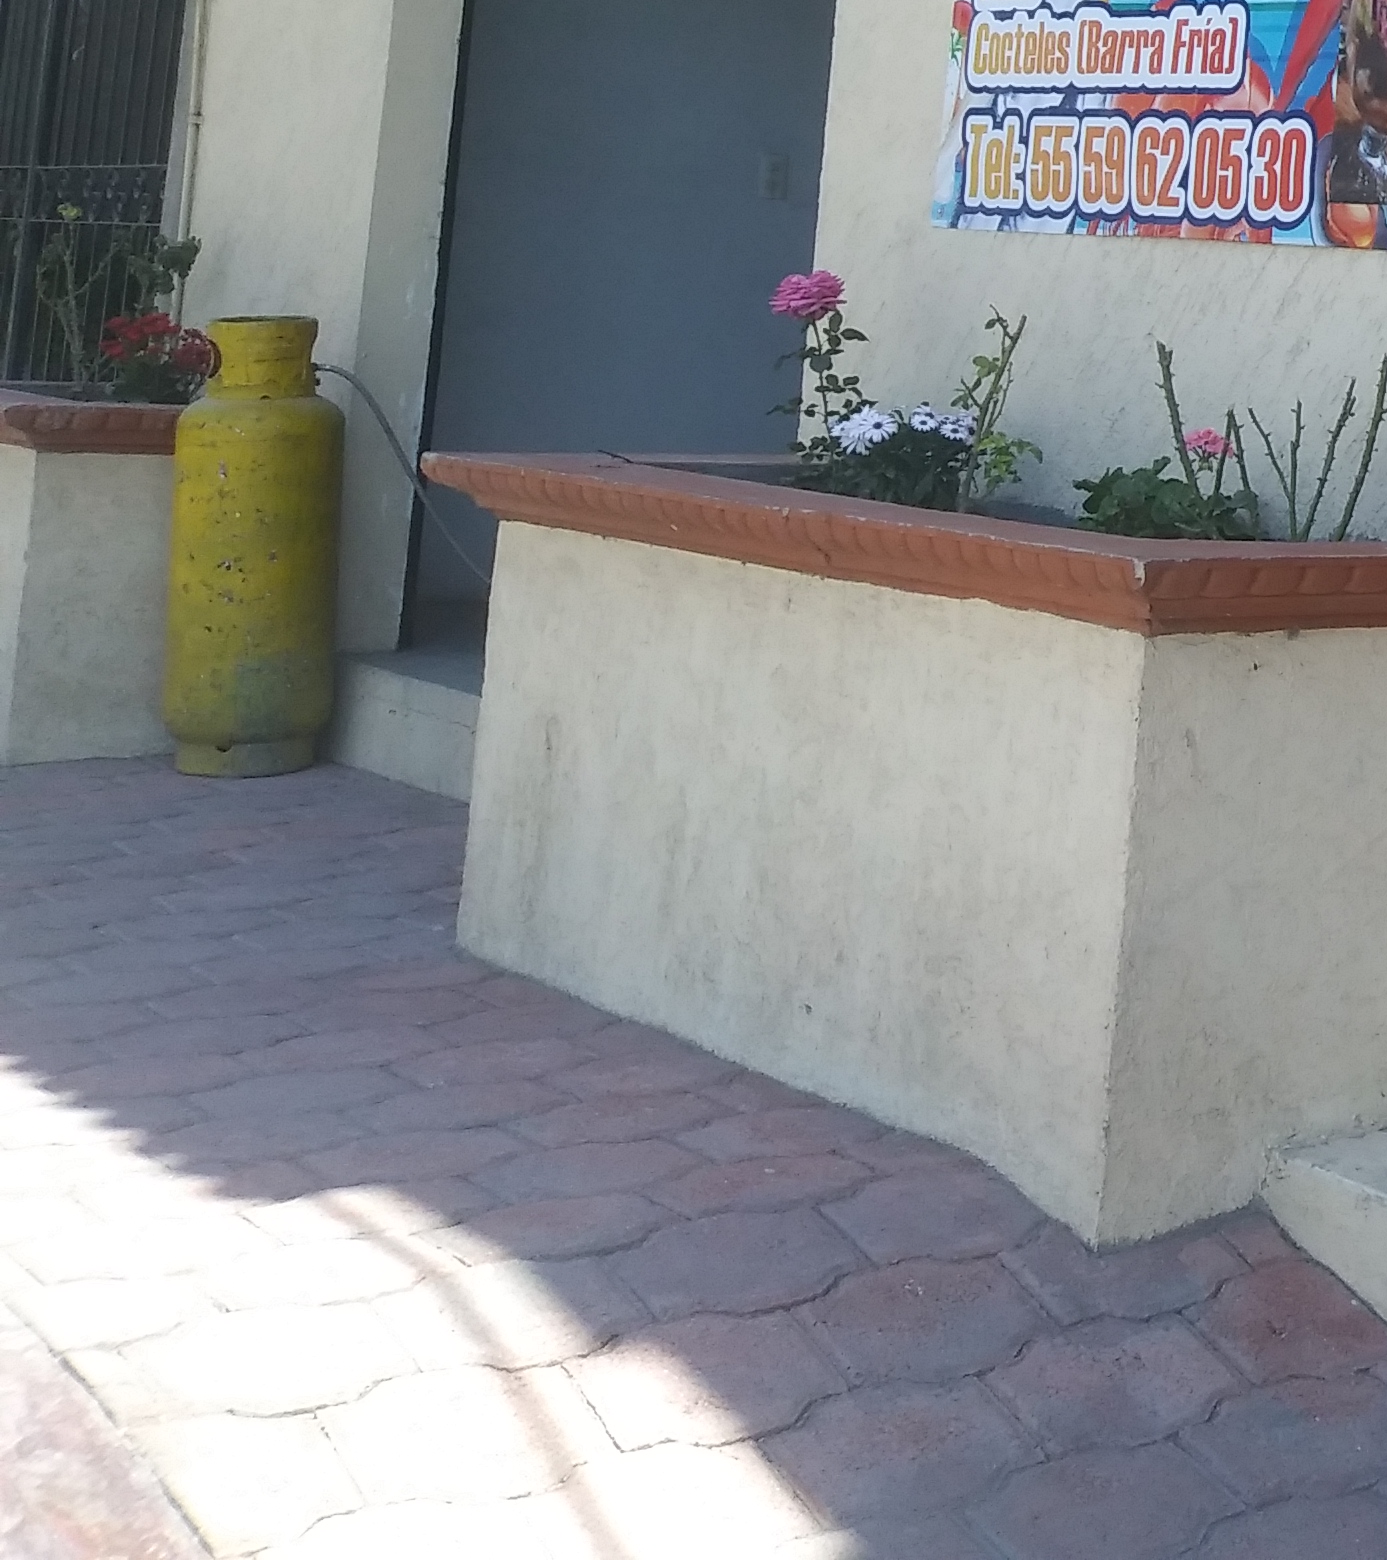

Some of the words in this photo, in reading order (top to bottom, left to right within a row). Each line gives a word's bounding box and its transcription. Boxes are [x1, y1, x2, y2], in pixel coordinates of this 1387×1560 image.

[973, 21, 1070, 75] Cocteles
[1076, 18, 1165, 75] (Barra
[1171, 16, 1239, 75] Fría)
[968, 123, 1020, 201] Tel:
[1030, 124, 1075, 203] 55
[1082, 125, 1129, 205] 59
[1135, 127, 1185, 208] 62
[1192, 127, 1247, 210] 05
[1254, 126, 1307, 213] 30
